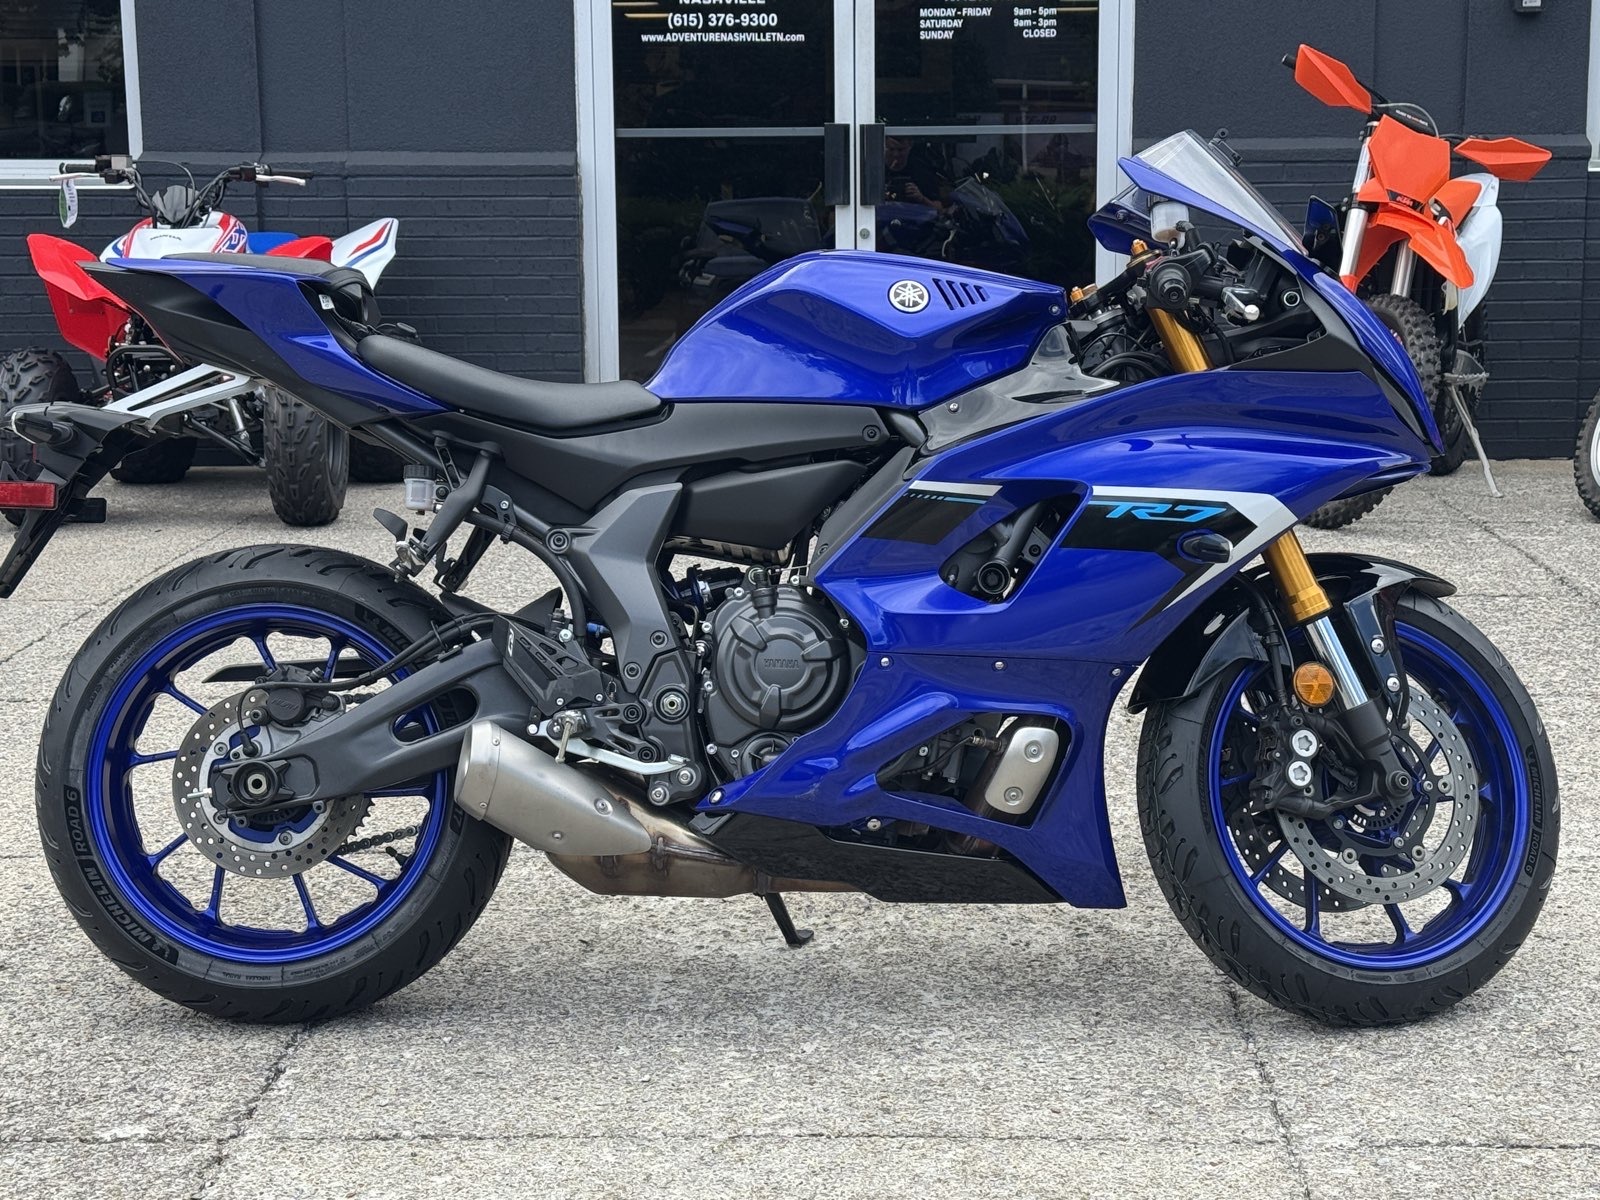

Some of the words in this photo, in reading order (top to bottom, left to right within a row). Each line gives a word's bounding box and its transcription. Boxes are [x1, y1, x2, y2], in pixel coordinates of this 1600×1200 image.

[920, 8, 957, 17] MONDAY
[962, 7, 992, 17] FRIDAY
[1013, 7, 1032, 15] 9am
[1038, 7, 1057, 17] 5pm
[667, 12, 704, 29] (615)
[708, 13, 778, 27] 376-9300
[920, 19, 963, 28] SATURDAY
[1013, 19, 1032, 27] 9am
[1038, 18, 1057, 28] 3pm
[641, 32, 805, 42] www.ADVENTURENASHVILLETN.com
[920, 30, 954, 39] SUNDAY
[1022, 29, 1057, 38] CLOSED
[1396, 195, 1413, 207] KTM
[1104, 502, 1227, 522] R7
[763, 658, 799, 669] YAMAHA
[67, 790, 78, 801] 6
[1530, 765, 1542, 827] MICHELIN
[68, 808, 88, 852] ROAD
[1528, 832, 1540, 863] ROAD
[84, 866, 151, 943] MICHELIN
